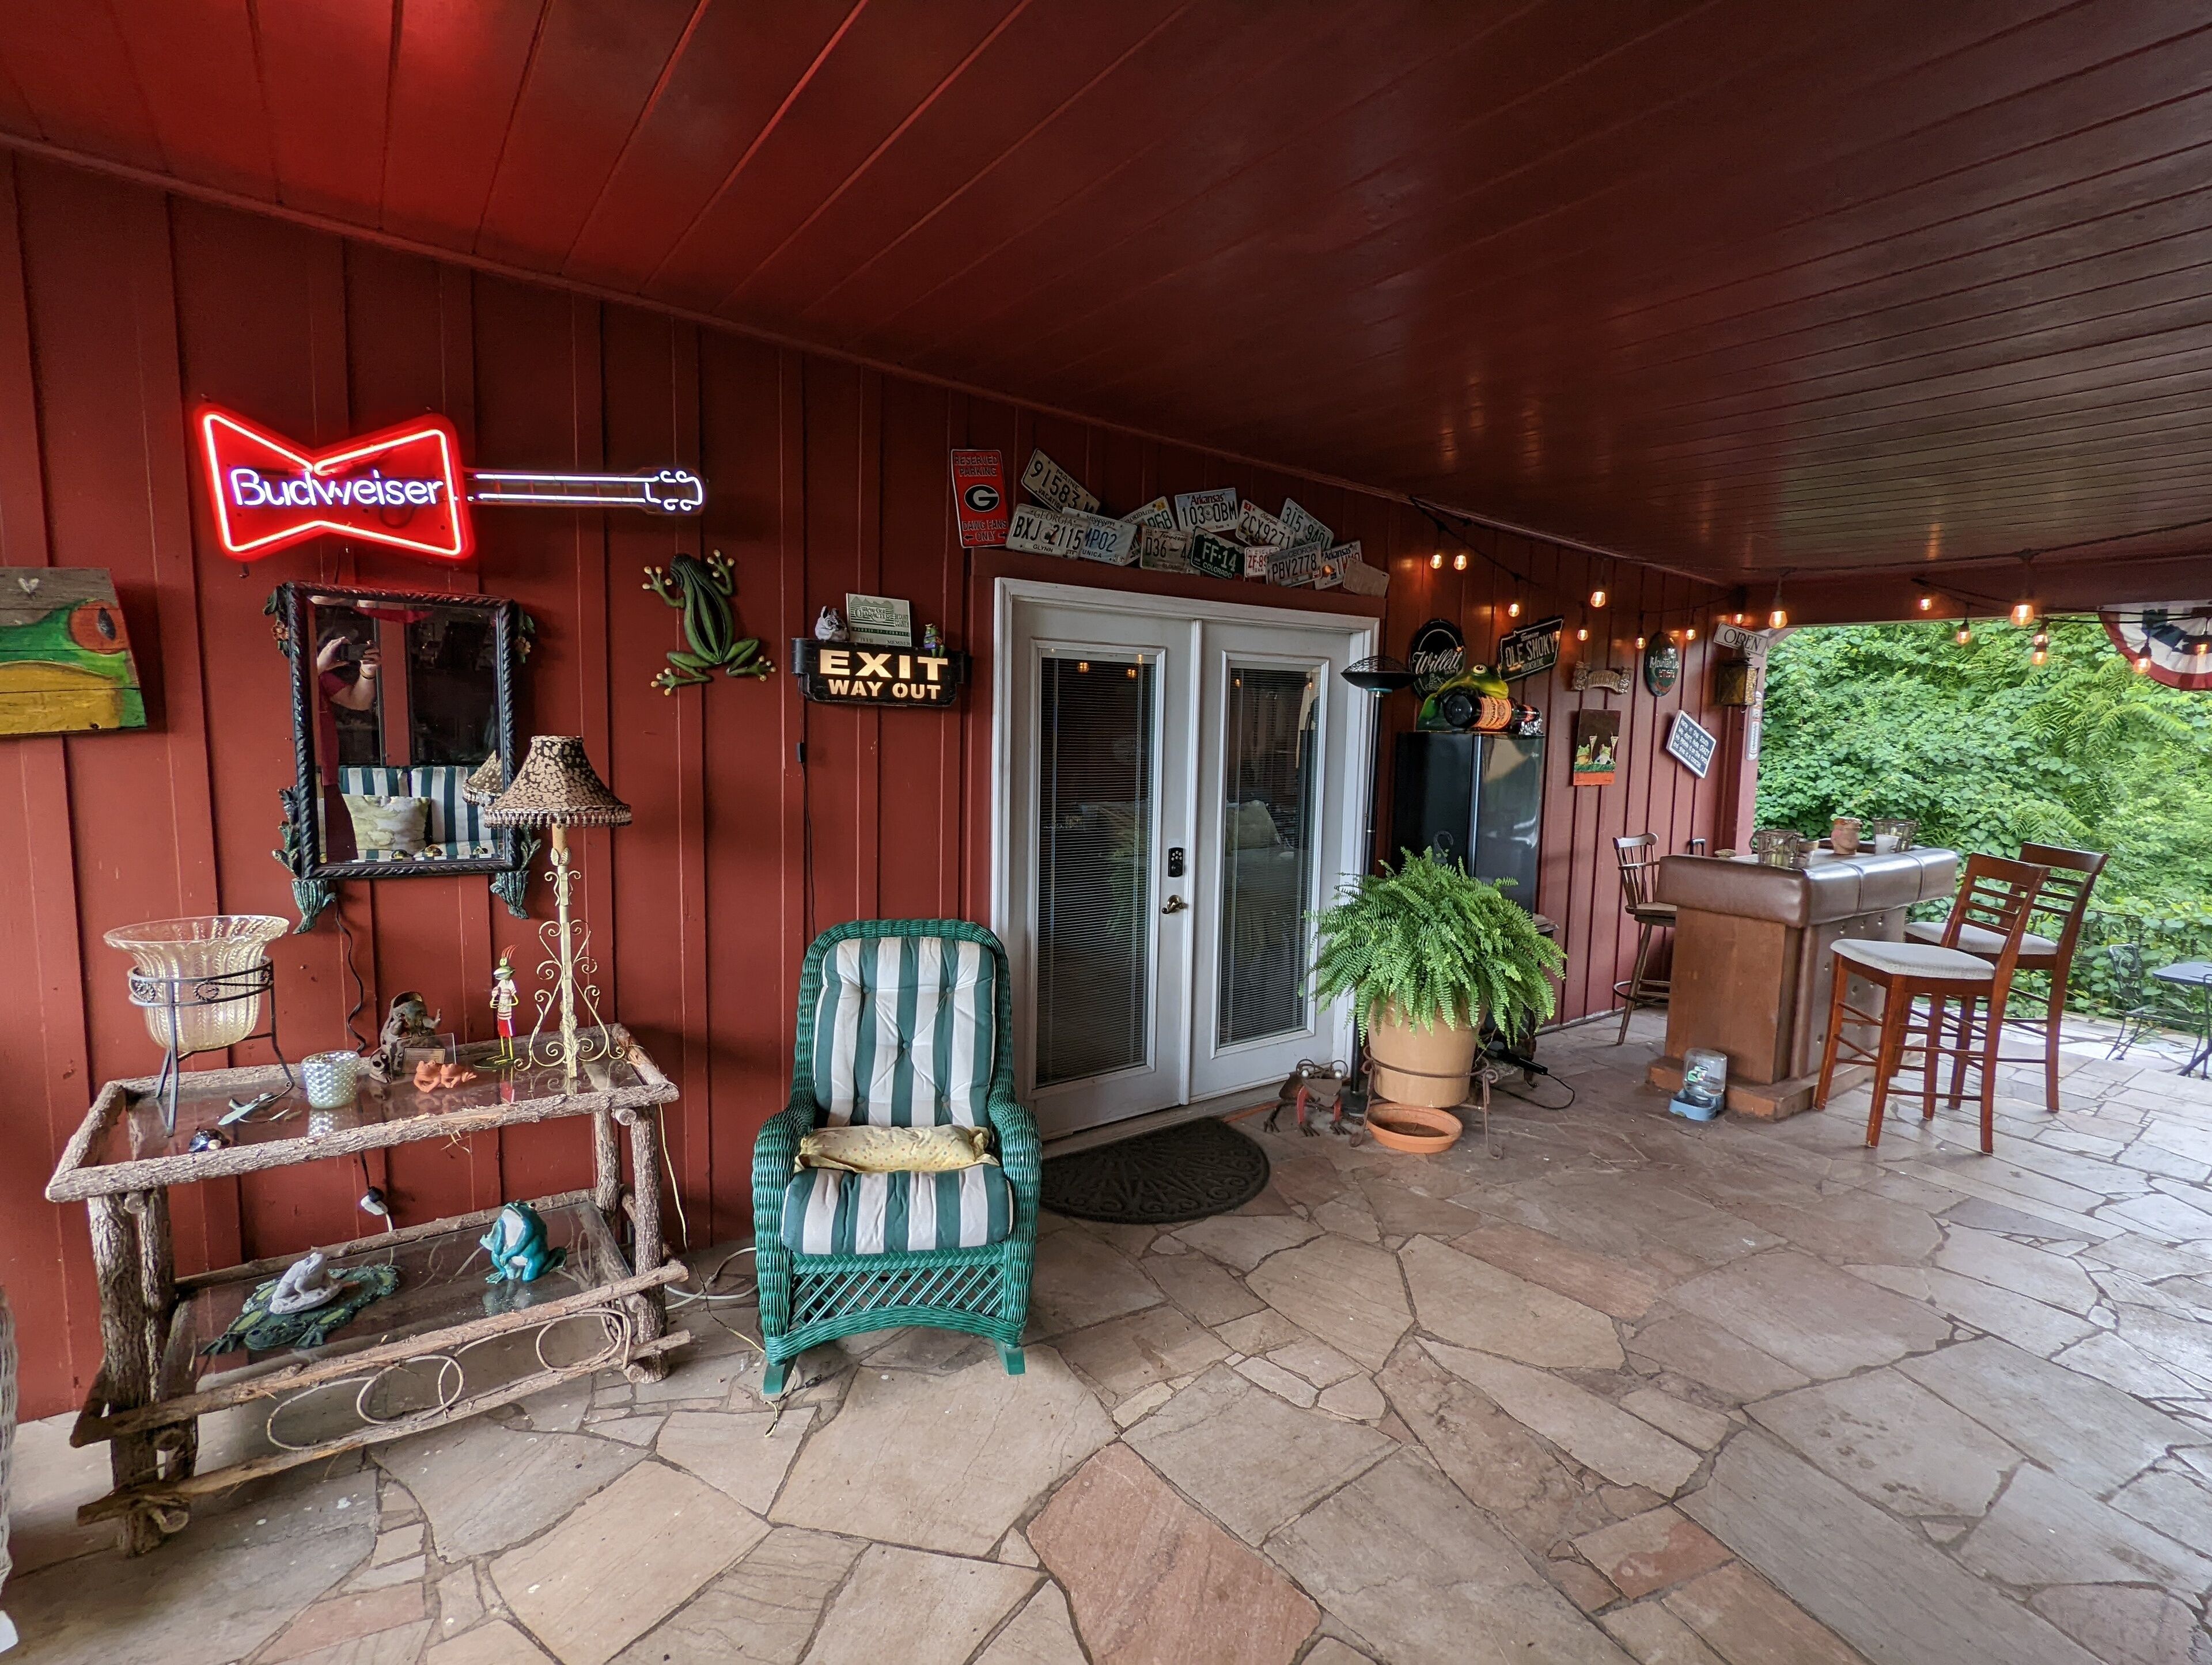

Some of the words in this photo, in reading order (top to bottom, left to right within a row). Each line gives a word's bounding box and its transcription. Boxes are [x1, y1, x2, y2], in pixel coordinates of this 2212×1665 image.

[955, 456, 999, 465] RESERVED
[959, 467, 998, 477] PARKING
[1056, 469, 1080, 492] MAINE
[229, 468, 445, 506] Budweiser
[1030, 461, 1081, 508] 91583
[964, 484, 999, 512] G
[1038, 489, 1064, 513] VACATION
[1190, 493, 1224, 505] Arkansas
[962, 520, 986, 531] DAWG
[987, 520, 1007, 530] FANS
[1033, 510, 1074, 526] GEORGIA
[1283, 506, 1304, 532] 315
[975, 532, 996, 541] ONLY
[1013, 516, 1042, 541] BXJ
[1048, 525, 1084, 550] 2115
[1033, 544, 1054, 553] GLYNN
[1082, 549, 1101, 558] UNICA
[1288, 545, 1318, 559] GEORGIA
[1324, 547, 1351, 561] Arkansas
[1203, 562, 1233, 578] COLORADO
[1272, 553, 1317, 581] PBV2778
[1505, 643, 1524, 668] OLE
[1526, 632, 1555, 661] SMOKY
[1724, 629, 1762, 651] OPEN
[820, 650, 948, 680] EXIT
[1412, 648, 1463, 675] Willett
[828, 679, 882, 697] WAY
[892, 682, 941, 699] OUT
